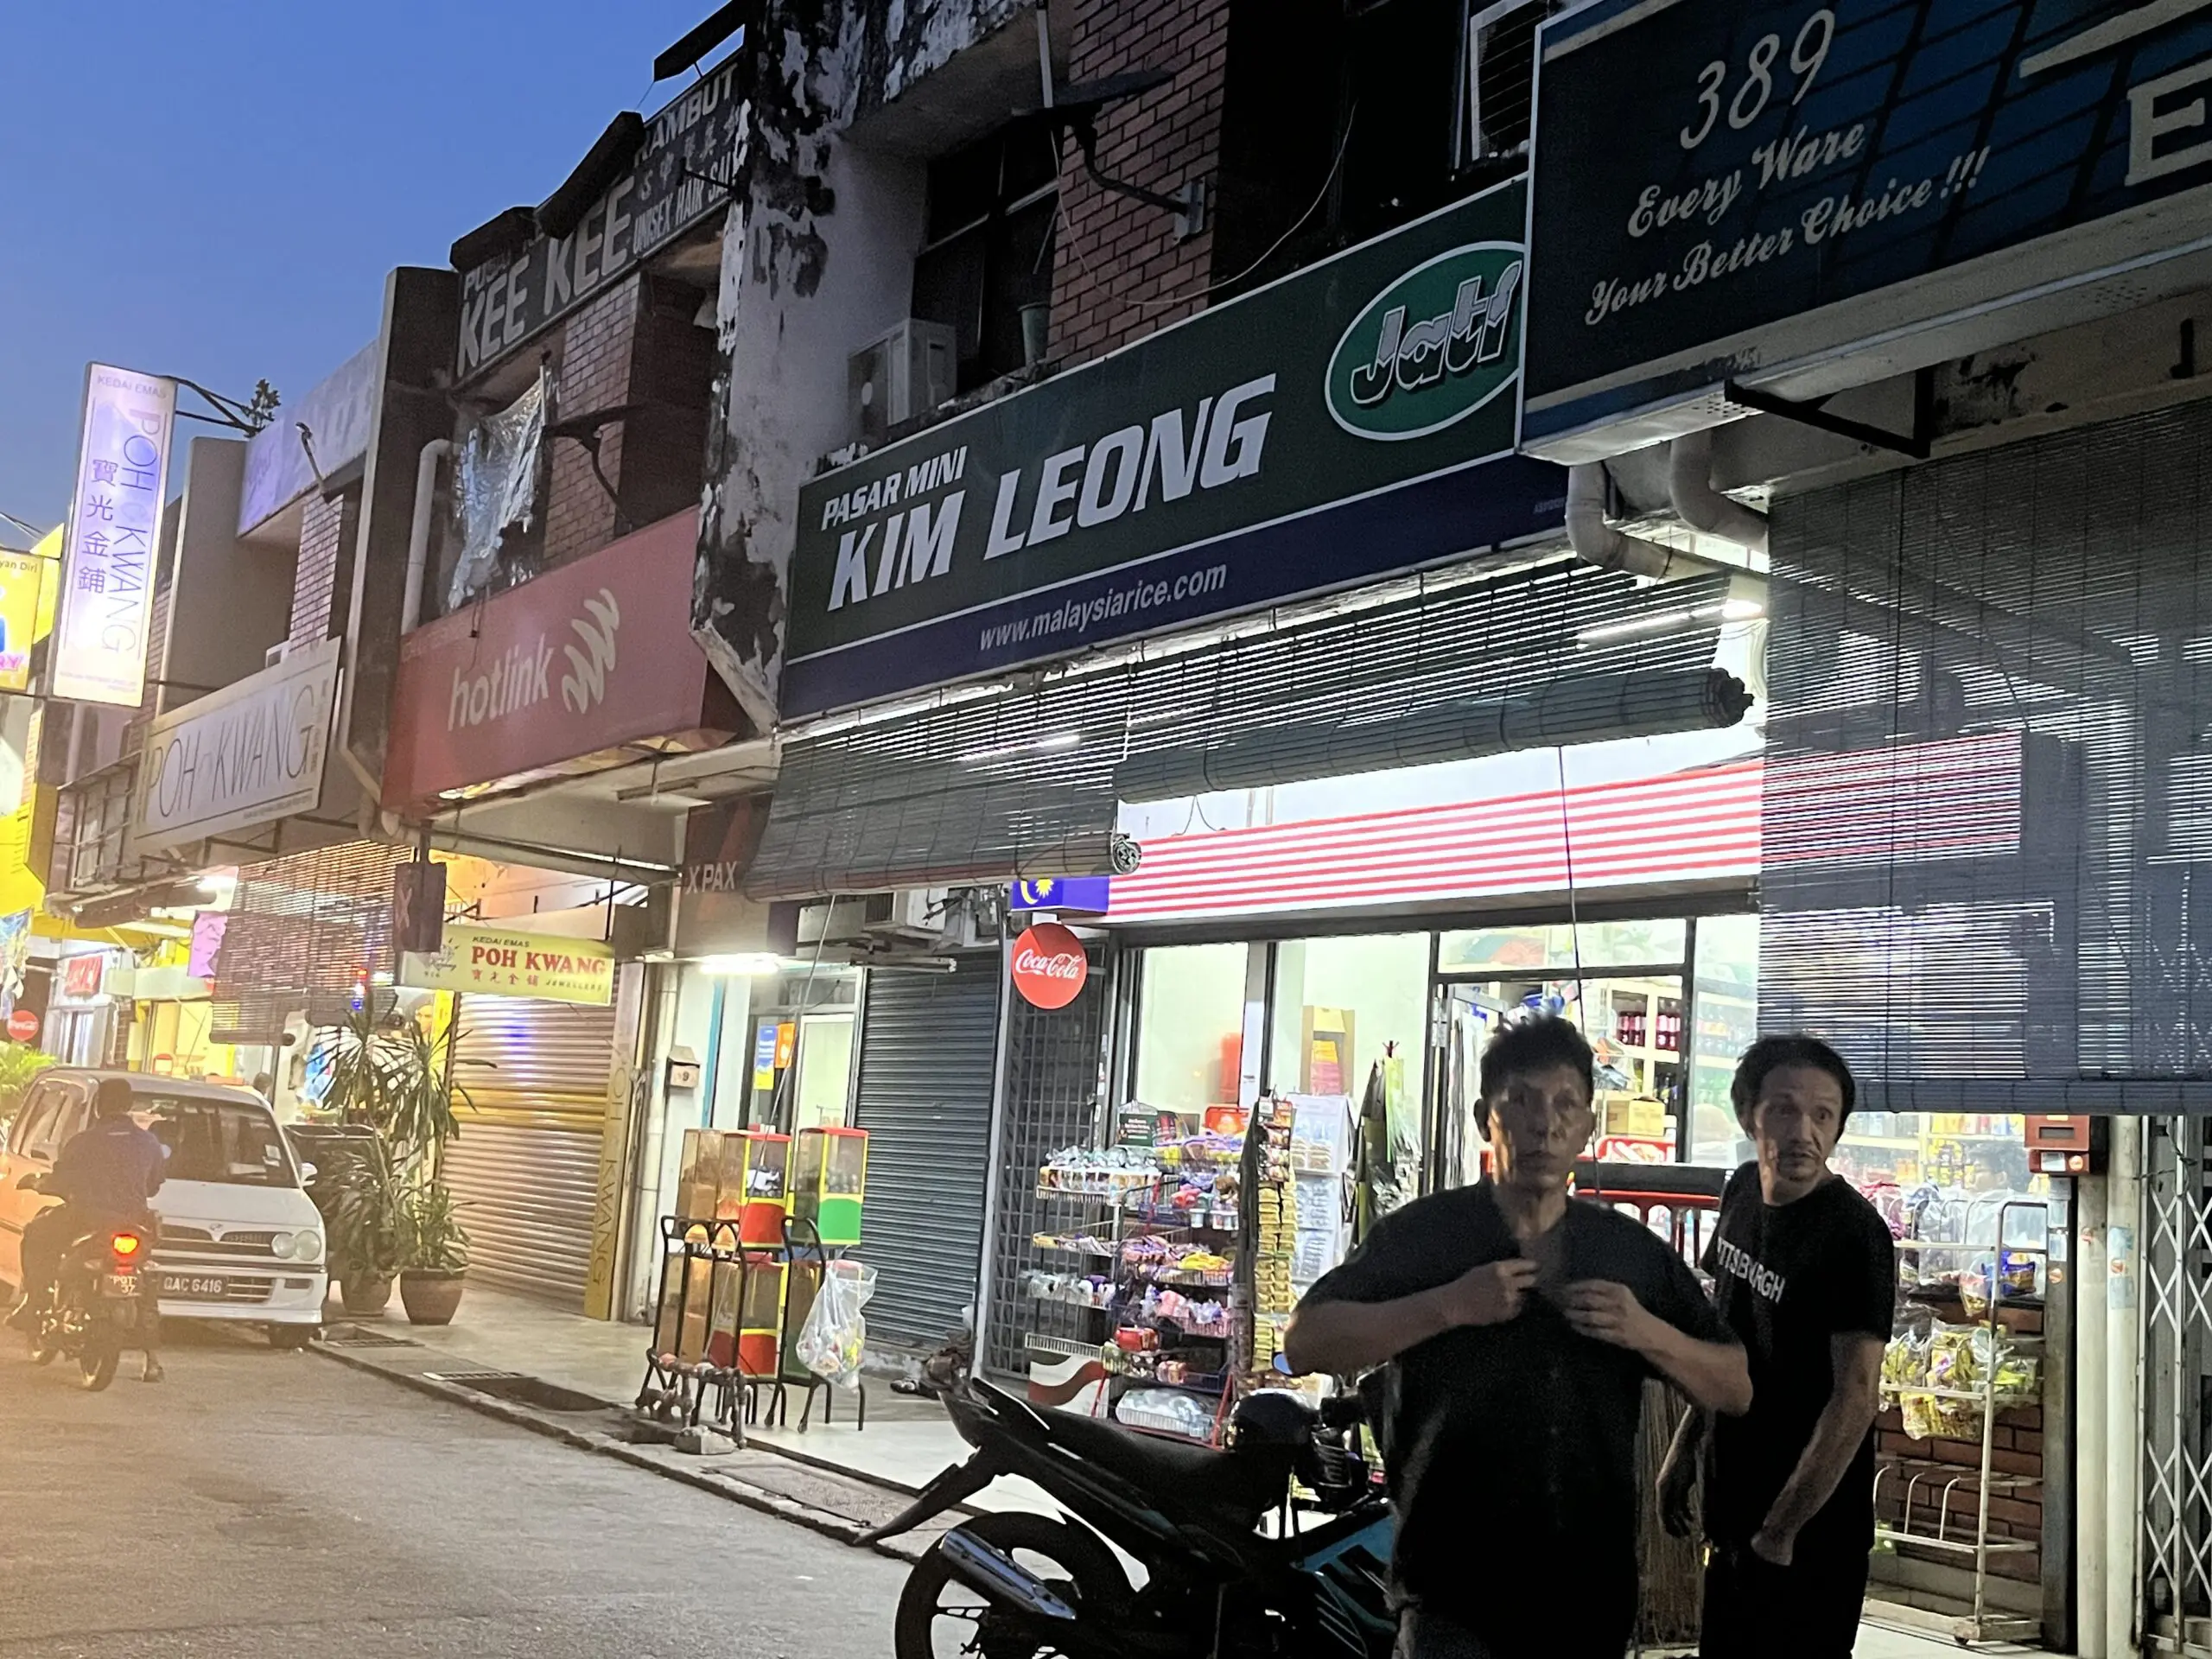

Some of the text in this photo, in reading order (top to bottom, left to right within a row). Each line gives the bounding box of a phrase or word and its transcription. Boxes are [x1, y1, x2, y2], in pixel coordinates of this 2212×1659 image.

[1679, 8, 1836, 149] 389
[1627, 123, 1866, 238] Every Ware
[457, 175, 635, 377] KEE KEE
[1585, 271, 1668, 326] Your
[1673, 226, 1793, 292] Better
[1802, 179, 1932, 245] Choice
[97, 376, 168, 399] KEDAI EMAS
[121, 409, 162, 493] POH
[821, 446, 968, 531] PASAR MINI
[827, 373, 1277, 613] KIM LEONG
[101, 525, 149, 653] KWANG
[979, 563, 1228, 652] www.malaysiarice.com
[448, 633, 555, 732] hotlink
[144, 731, 201, 823] POH
[212, 684, 315, 803] KWANG
[684, 861, 738, 895] XPAX
[471, 945, 517, 968] POH
[525, 951, 606, 975] KWANG
[472, 936, 530, 948] KEDAI EMAS
[1015, 949, 1086, 980] Coca-Cola
[192, 1279, 223, 1293] 6416
